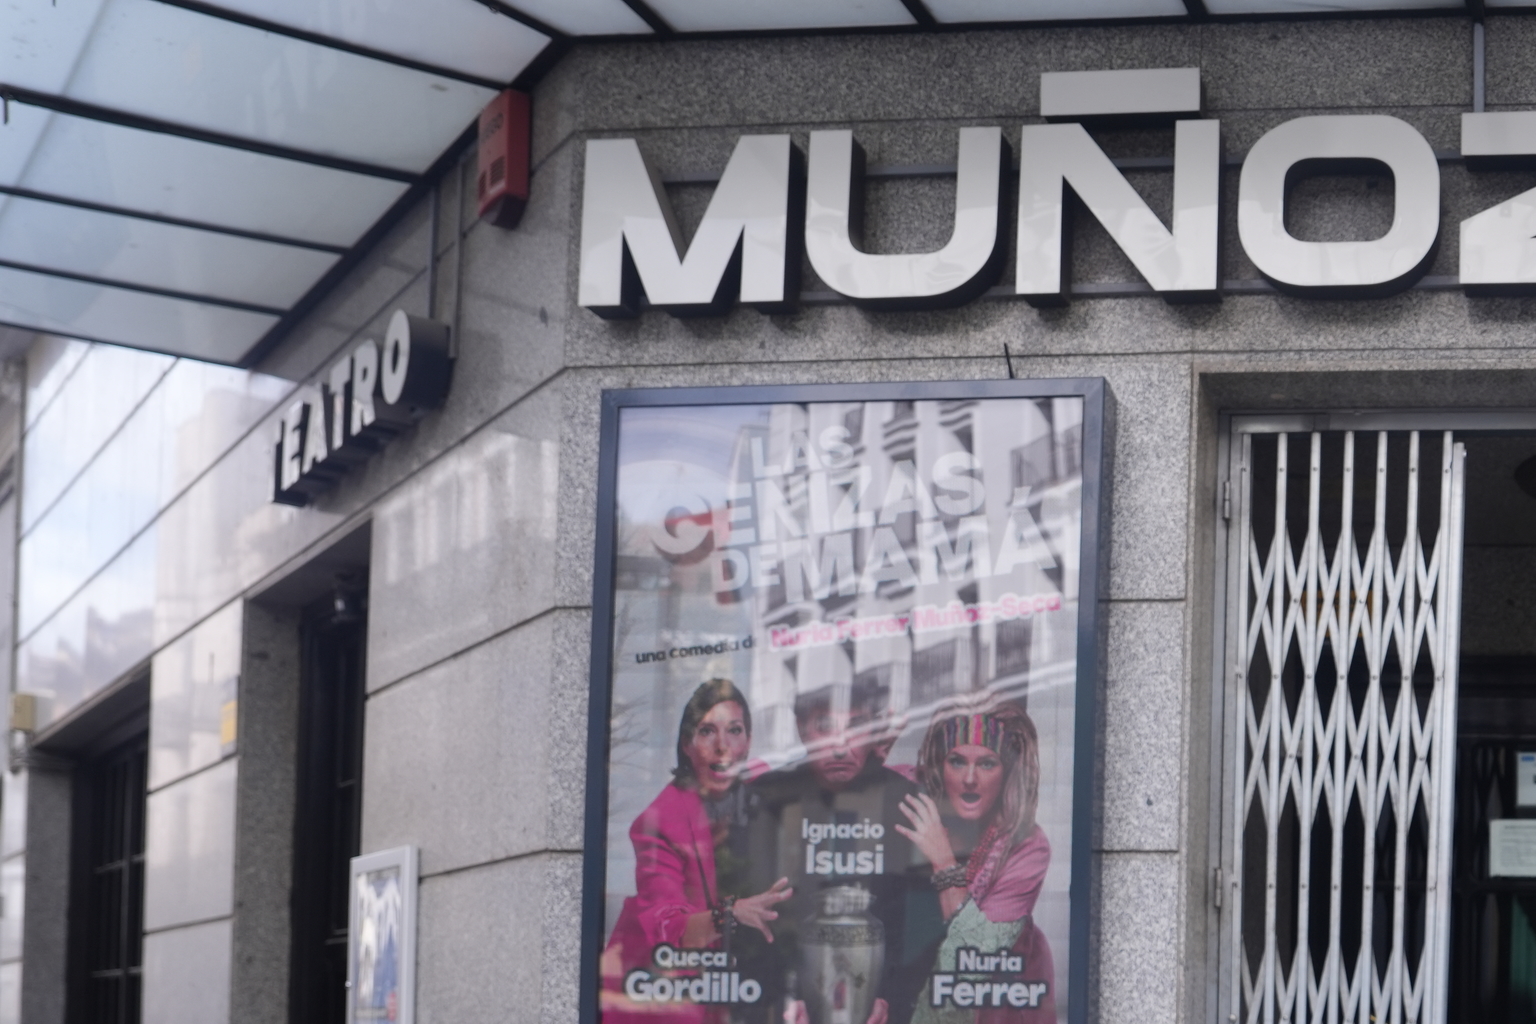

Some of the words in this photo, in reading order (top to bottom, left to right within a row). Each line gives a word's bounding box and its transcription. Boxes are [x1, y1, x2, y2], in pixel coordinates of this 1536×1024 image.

[751, 425, 854, 478] LAS
[651, 452, 986, 553] CENIZAS
[713, 543, 781, 594] DE
[782, 486, 1057, 603] MAMÁ
[636, 645, 666, 664] una
[669, 638, 739, 659] comedia
[771, 624, 832, 647] Nuria
[837, 618, 909, 639] Ferrer
[802, 819, 884, 842] Ignacio
[806, 845, 883, 875] Isusi
[655, 946, 727, 969] Queca
[958, 949, 1021, 972] Nuria
[625, 972, 762, 1003] Gordillo
[933, 975, 1046, 1007] Ferrer
